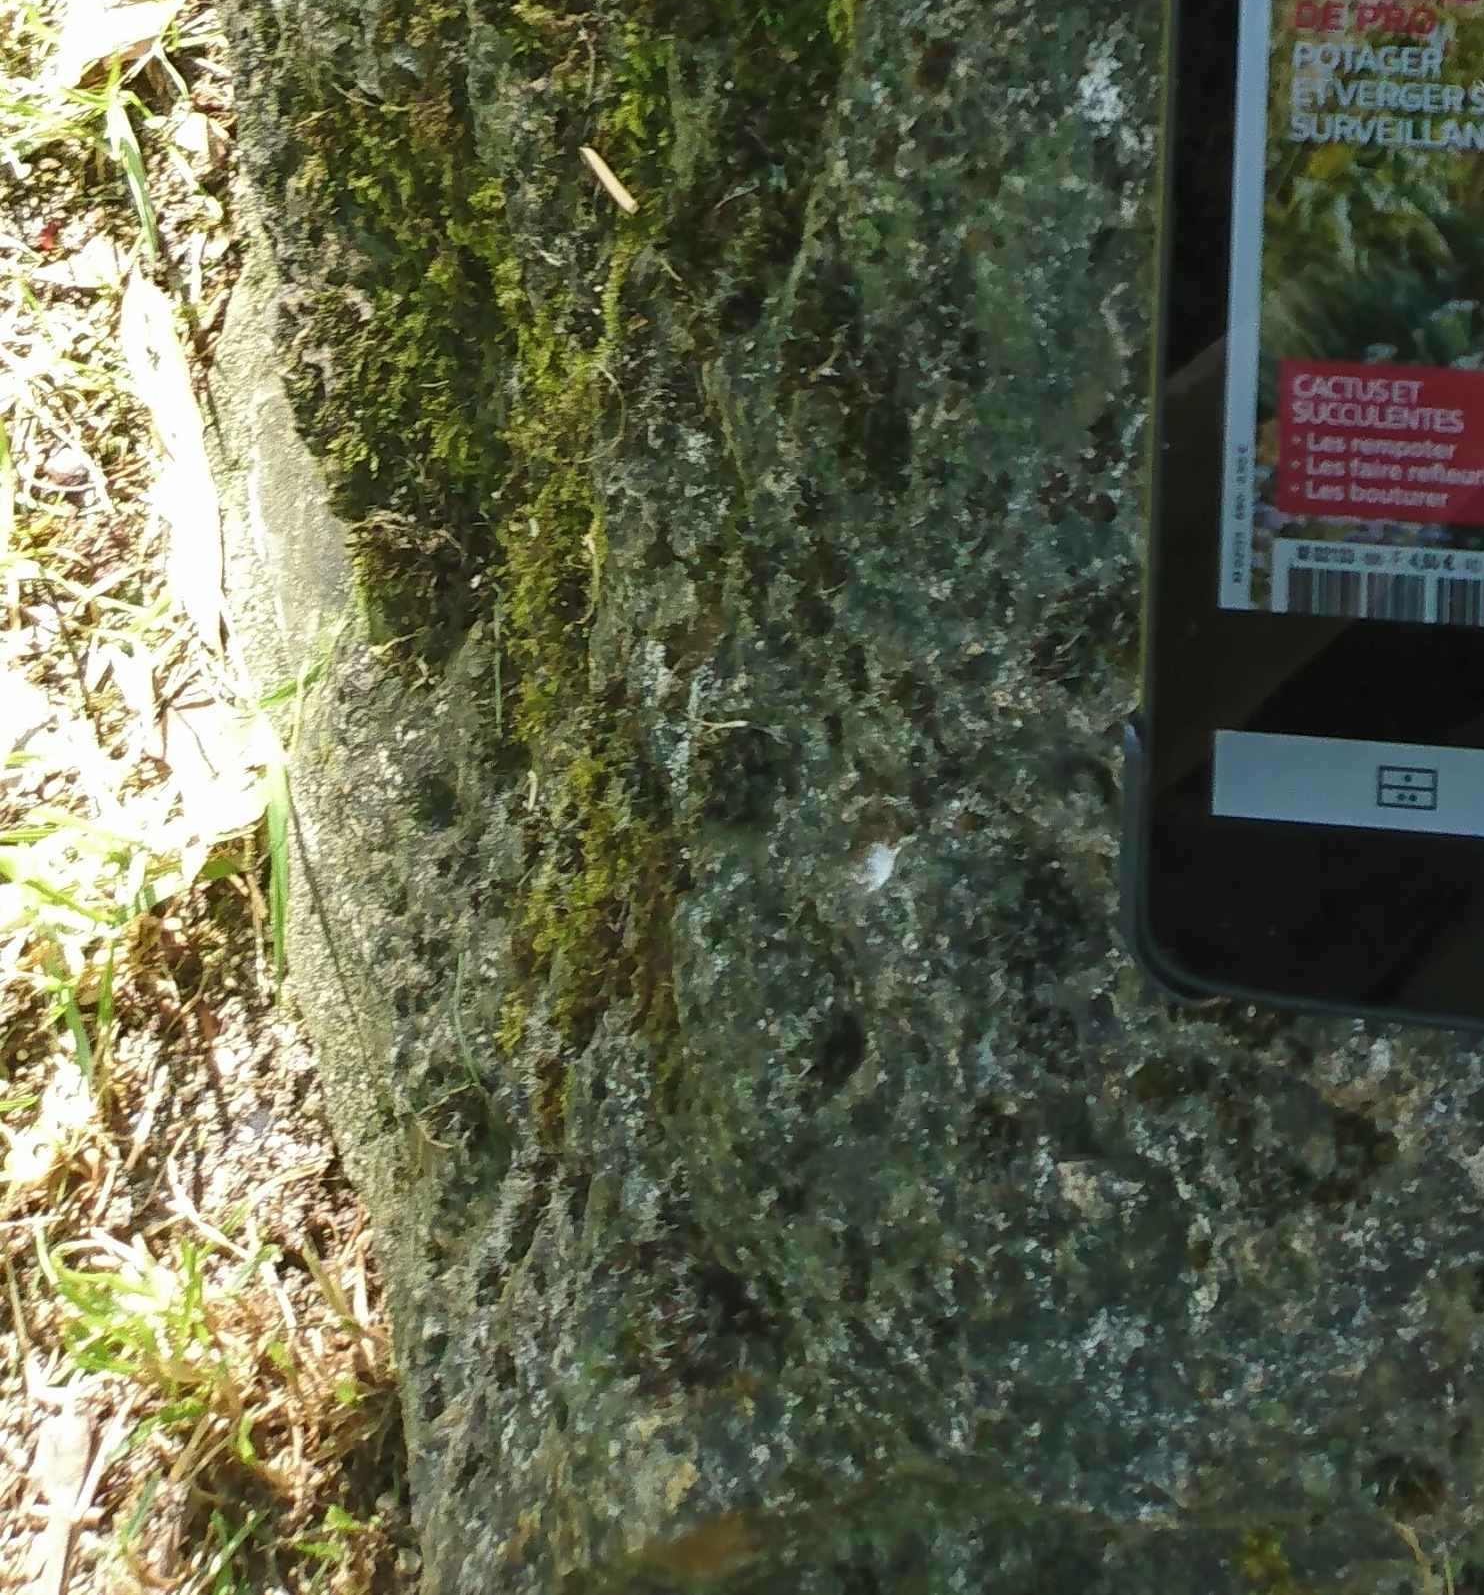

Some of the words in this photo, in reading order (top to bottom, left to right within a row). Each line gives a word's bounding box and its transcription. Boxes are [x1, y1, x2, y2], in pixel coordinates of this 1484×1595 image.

[1295, 0, 1346, 33] DE
[1355, 5, 1437, 37] PRO
[1292, 40, 1443, 79] POTAGER
[1329, 80, 1465, 115] VERGER
[1293, 373, 1389, 403] CACTUS
[1391, 380, 1425, 404] ET
[1291, 400, 1465, 434] SUCCULENTES
